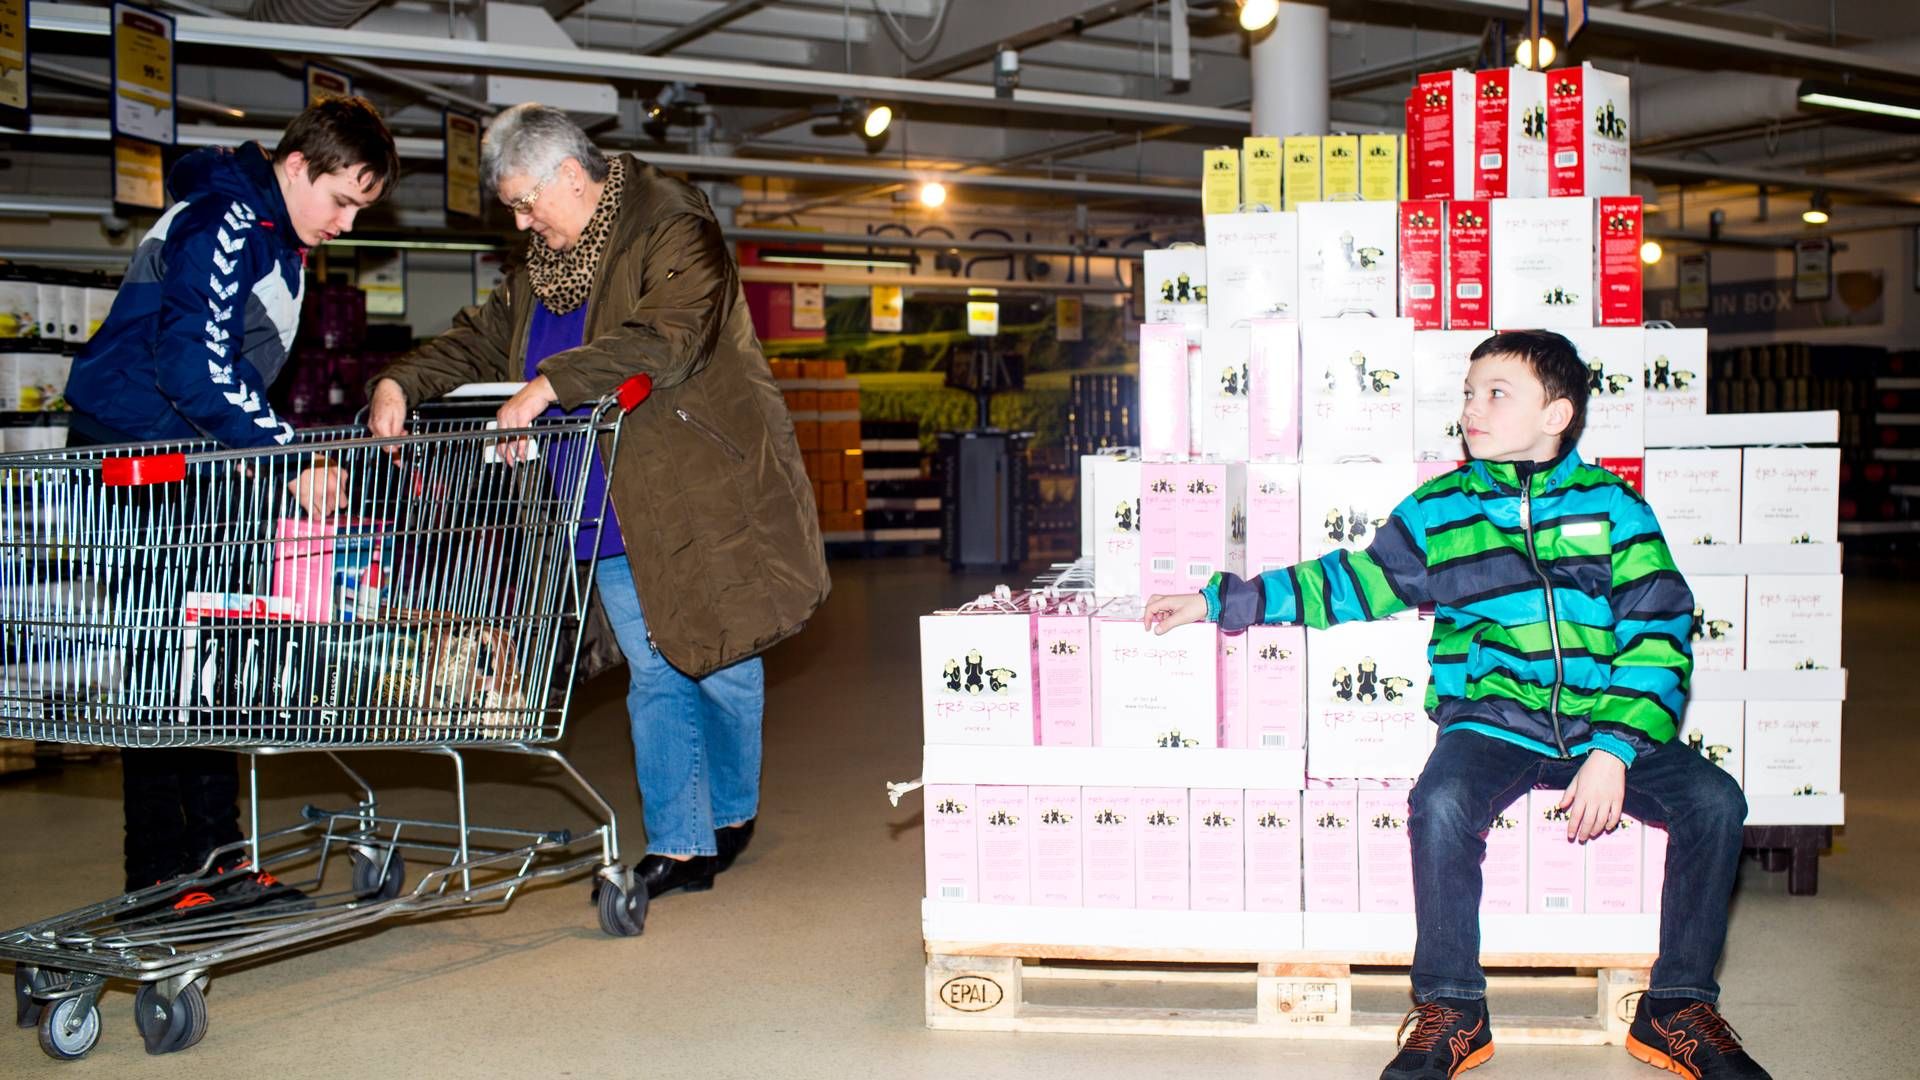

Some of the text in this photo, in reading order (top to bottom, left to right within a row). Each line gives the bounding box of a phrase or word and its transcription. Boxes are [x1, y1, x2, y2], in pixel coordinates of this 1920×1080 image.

[1714, 294, 1736, 315] IN
[1744, 289, 1792, 312] BOX
[951, 984, 993, 1004] EPAL
